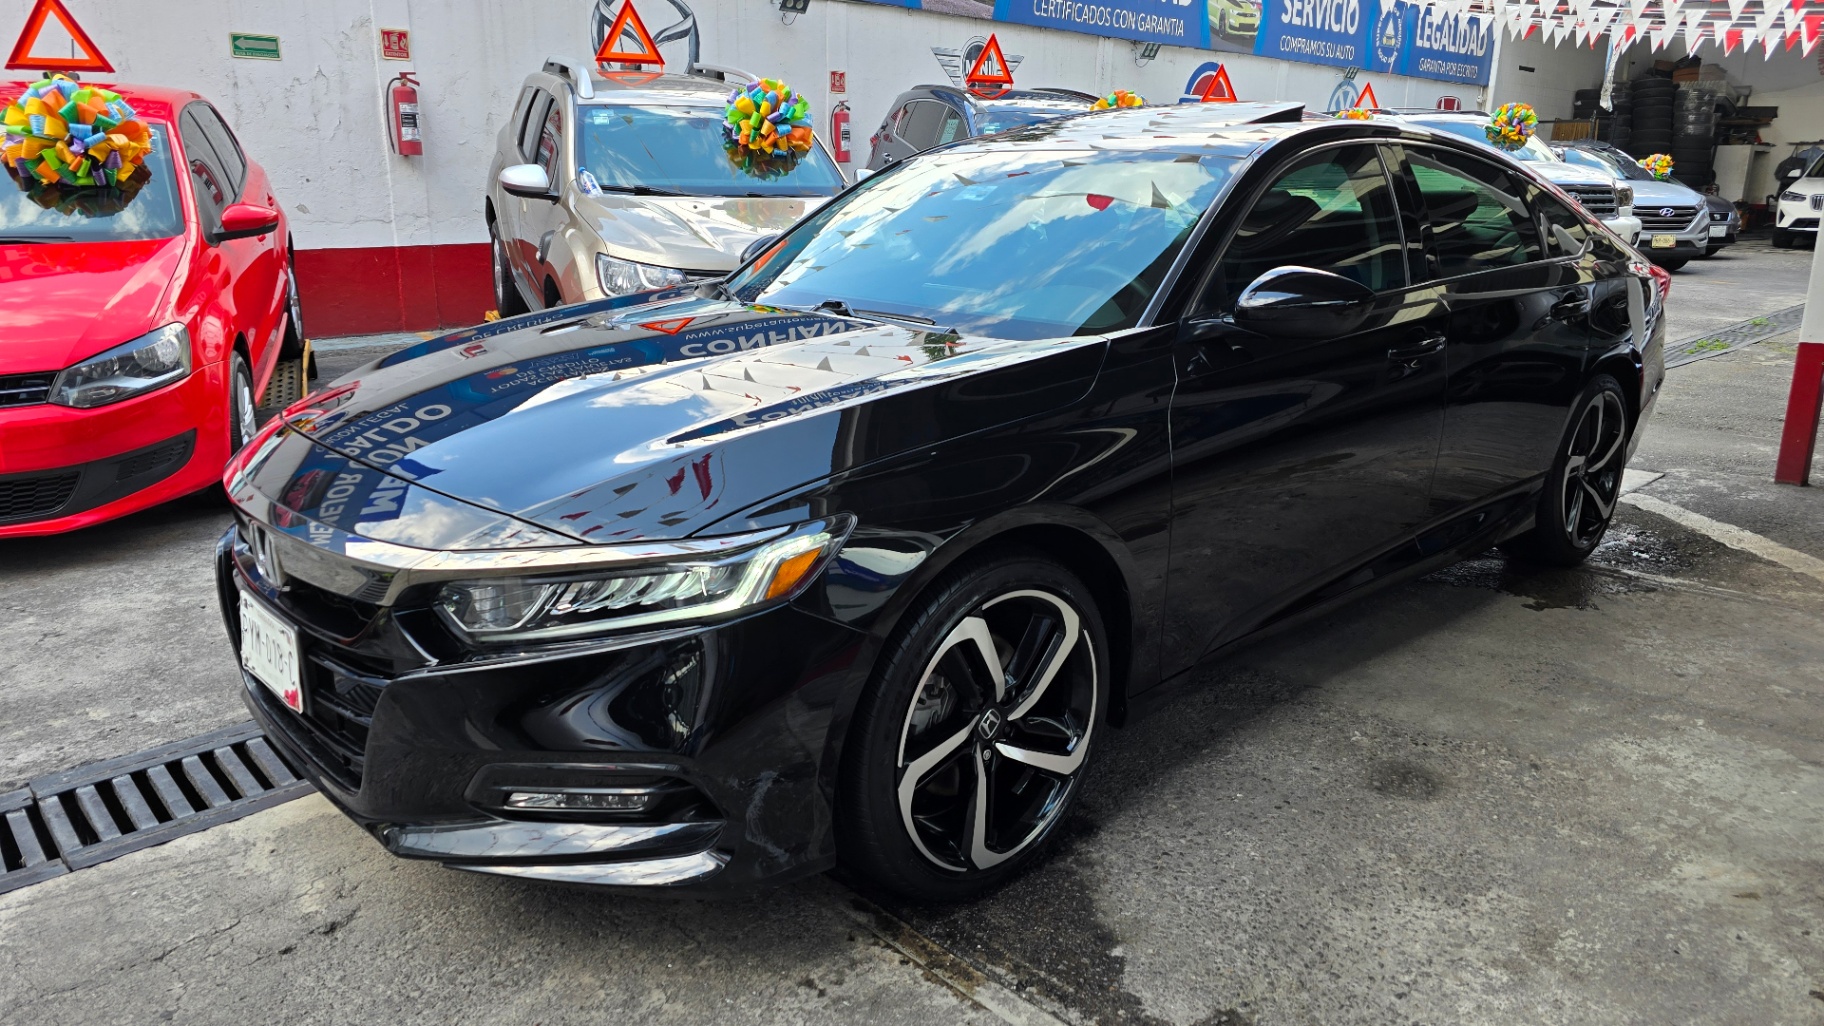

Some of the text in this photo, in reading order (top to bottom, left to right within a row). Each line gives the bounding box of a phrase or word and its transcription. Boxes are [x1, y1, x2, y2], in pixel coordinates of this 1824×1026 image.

[1033, 0, 1184, 37] CERTIFICADOS CON GARANTIA
[1281, 0, 1359, 35] SERVICIO
[1416, 13, 1488, 57] LEGALIDAD
[1280, 35, 1355, 61] COMPRAMOS SU AUTO
